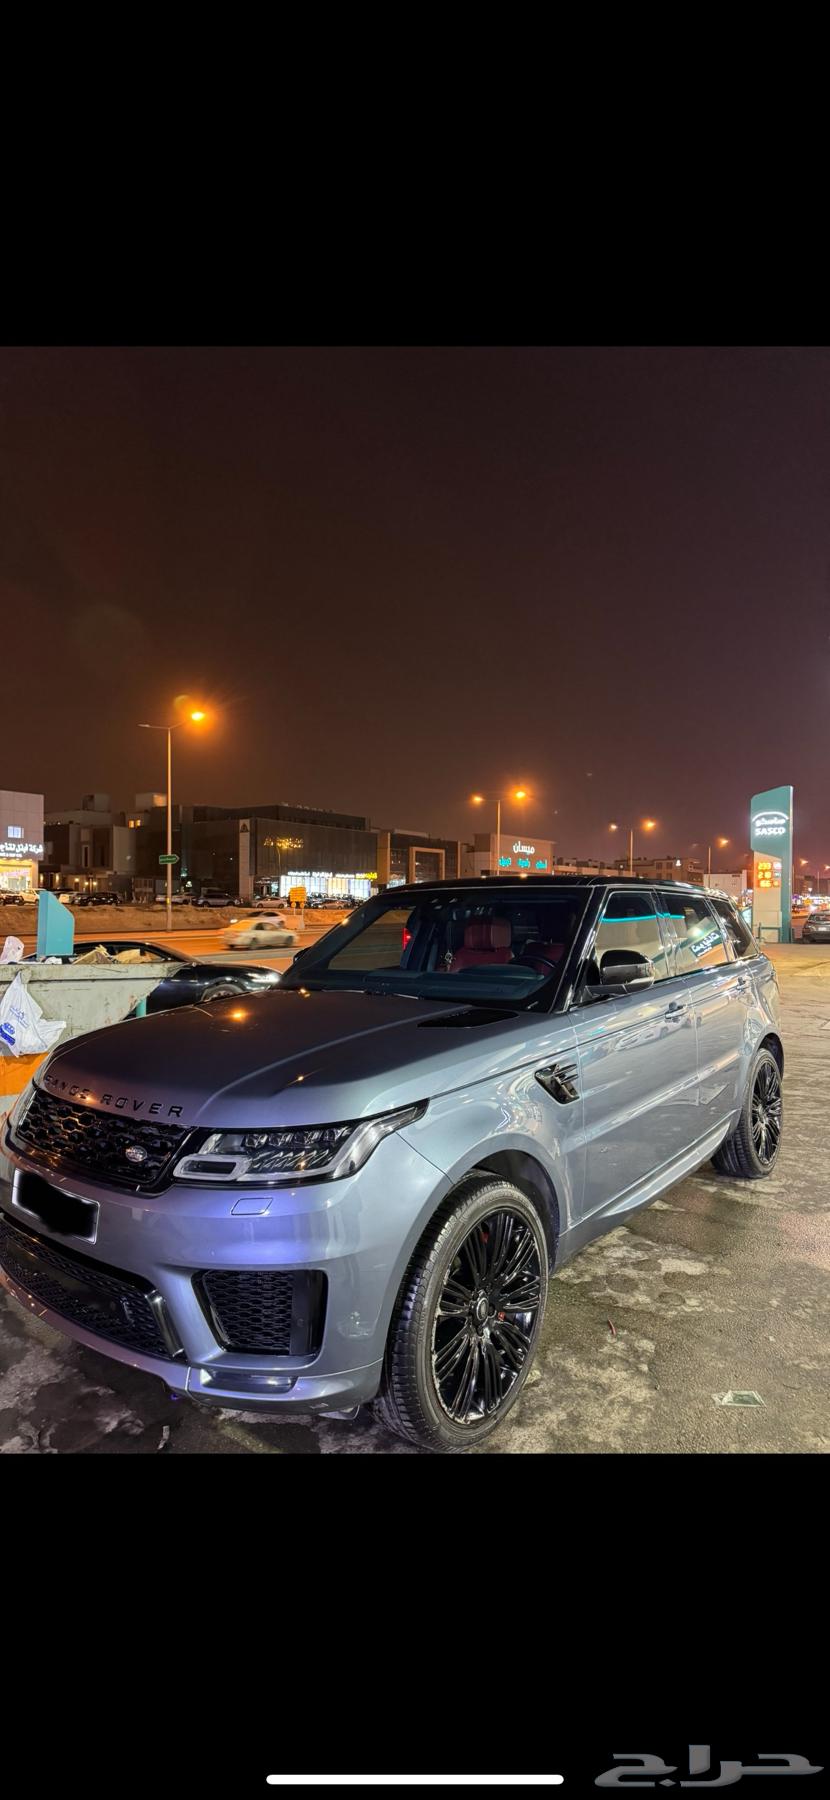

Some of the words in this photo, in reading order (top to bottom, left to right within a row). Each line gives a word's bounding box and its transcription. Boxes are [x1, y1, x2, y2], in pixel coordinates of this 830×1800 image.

[755, 827, 786, 836] SASCO
[512, 841, 535, 855] ميسان
[43, 1075, 90, 1099] RANGE
[101, 1093, 184, 1118] ROVER
